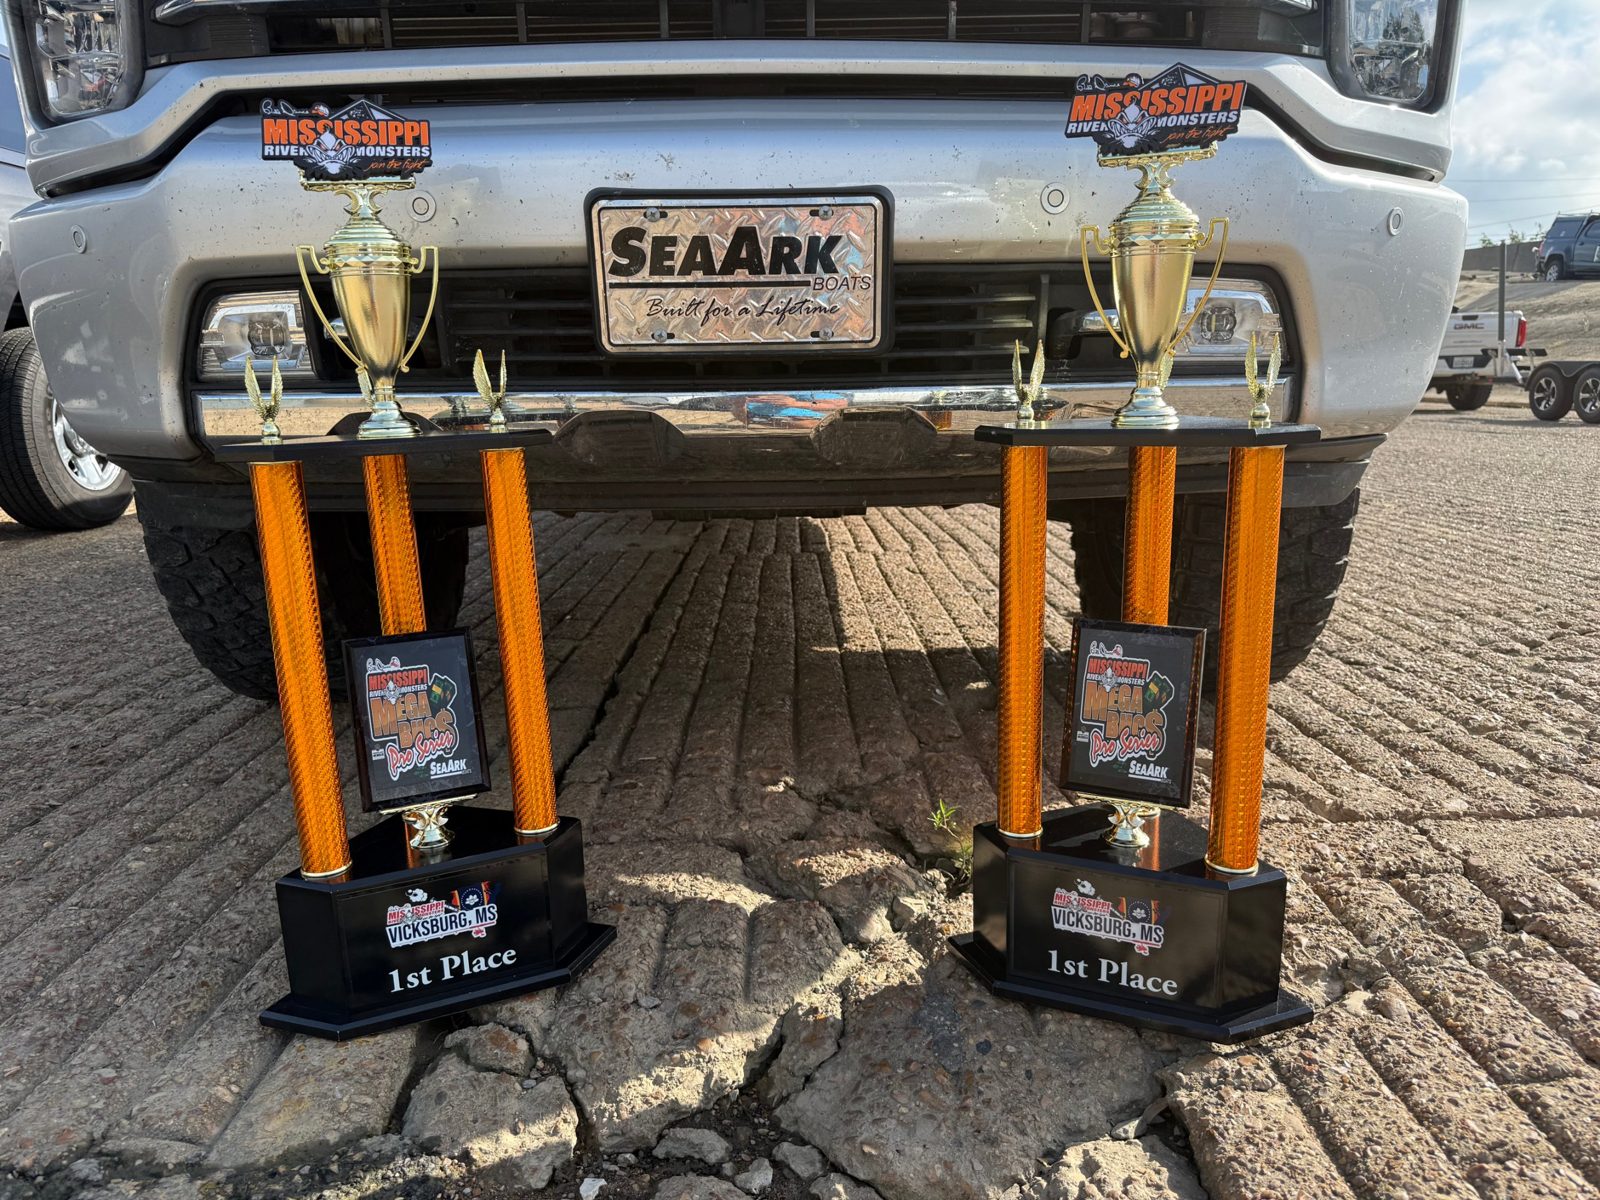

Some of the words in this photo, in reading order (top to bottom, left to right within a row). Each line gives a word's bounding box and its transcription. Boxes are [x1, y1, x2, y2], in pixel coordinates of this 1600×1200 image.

[1070, 82, 1244, 122] MISSISSIPPI
[1155, 111, 1238, 128] MONSTERS
[263, 118, 429, 146] MISSISSIPPI
[354, 145, 430, 157] MONSTERS
[812, 276, 872, 291] BOATS
[646, 296, 705, 318] Built
[701, 298, 732, 328] for
[738, 305, 751, 317] a
[756, 296, 841, 326] Lifetime
[370, 691, 432, 737] MEGA
[1083, 681, 1143, 721] MEGA
[387, 746, 413, 776] Pro
[415, 729, 455, 762] Series
[1091, 731, 1116, 762] Pro
[1119, 727, 1160, 758] Series
[388, 901, 444, 920] MISISSIPPI
[1055, 893, 1110, 910] MISISSIPPI
[388, 911, 472, 943] VICKSBURG,
[475, 905, 497, 924] MS
[1053, 907, 1136, 939] VICKSBURG,
[1140, 925, 1163, 944] MS
[388, 966, 433, 993] 1st
[440, 949, 517, 981] Place
[1047, 949, 1089, 978] 1st
[1097, 957, 1178, 996] Place
